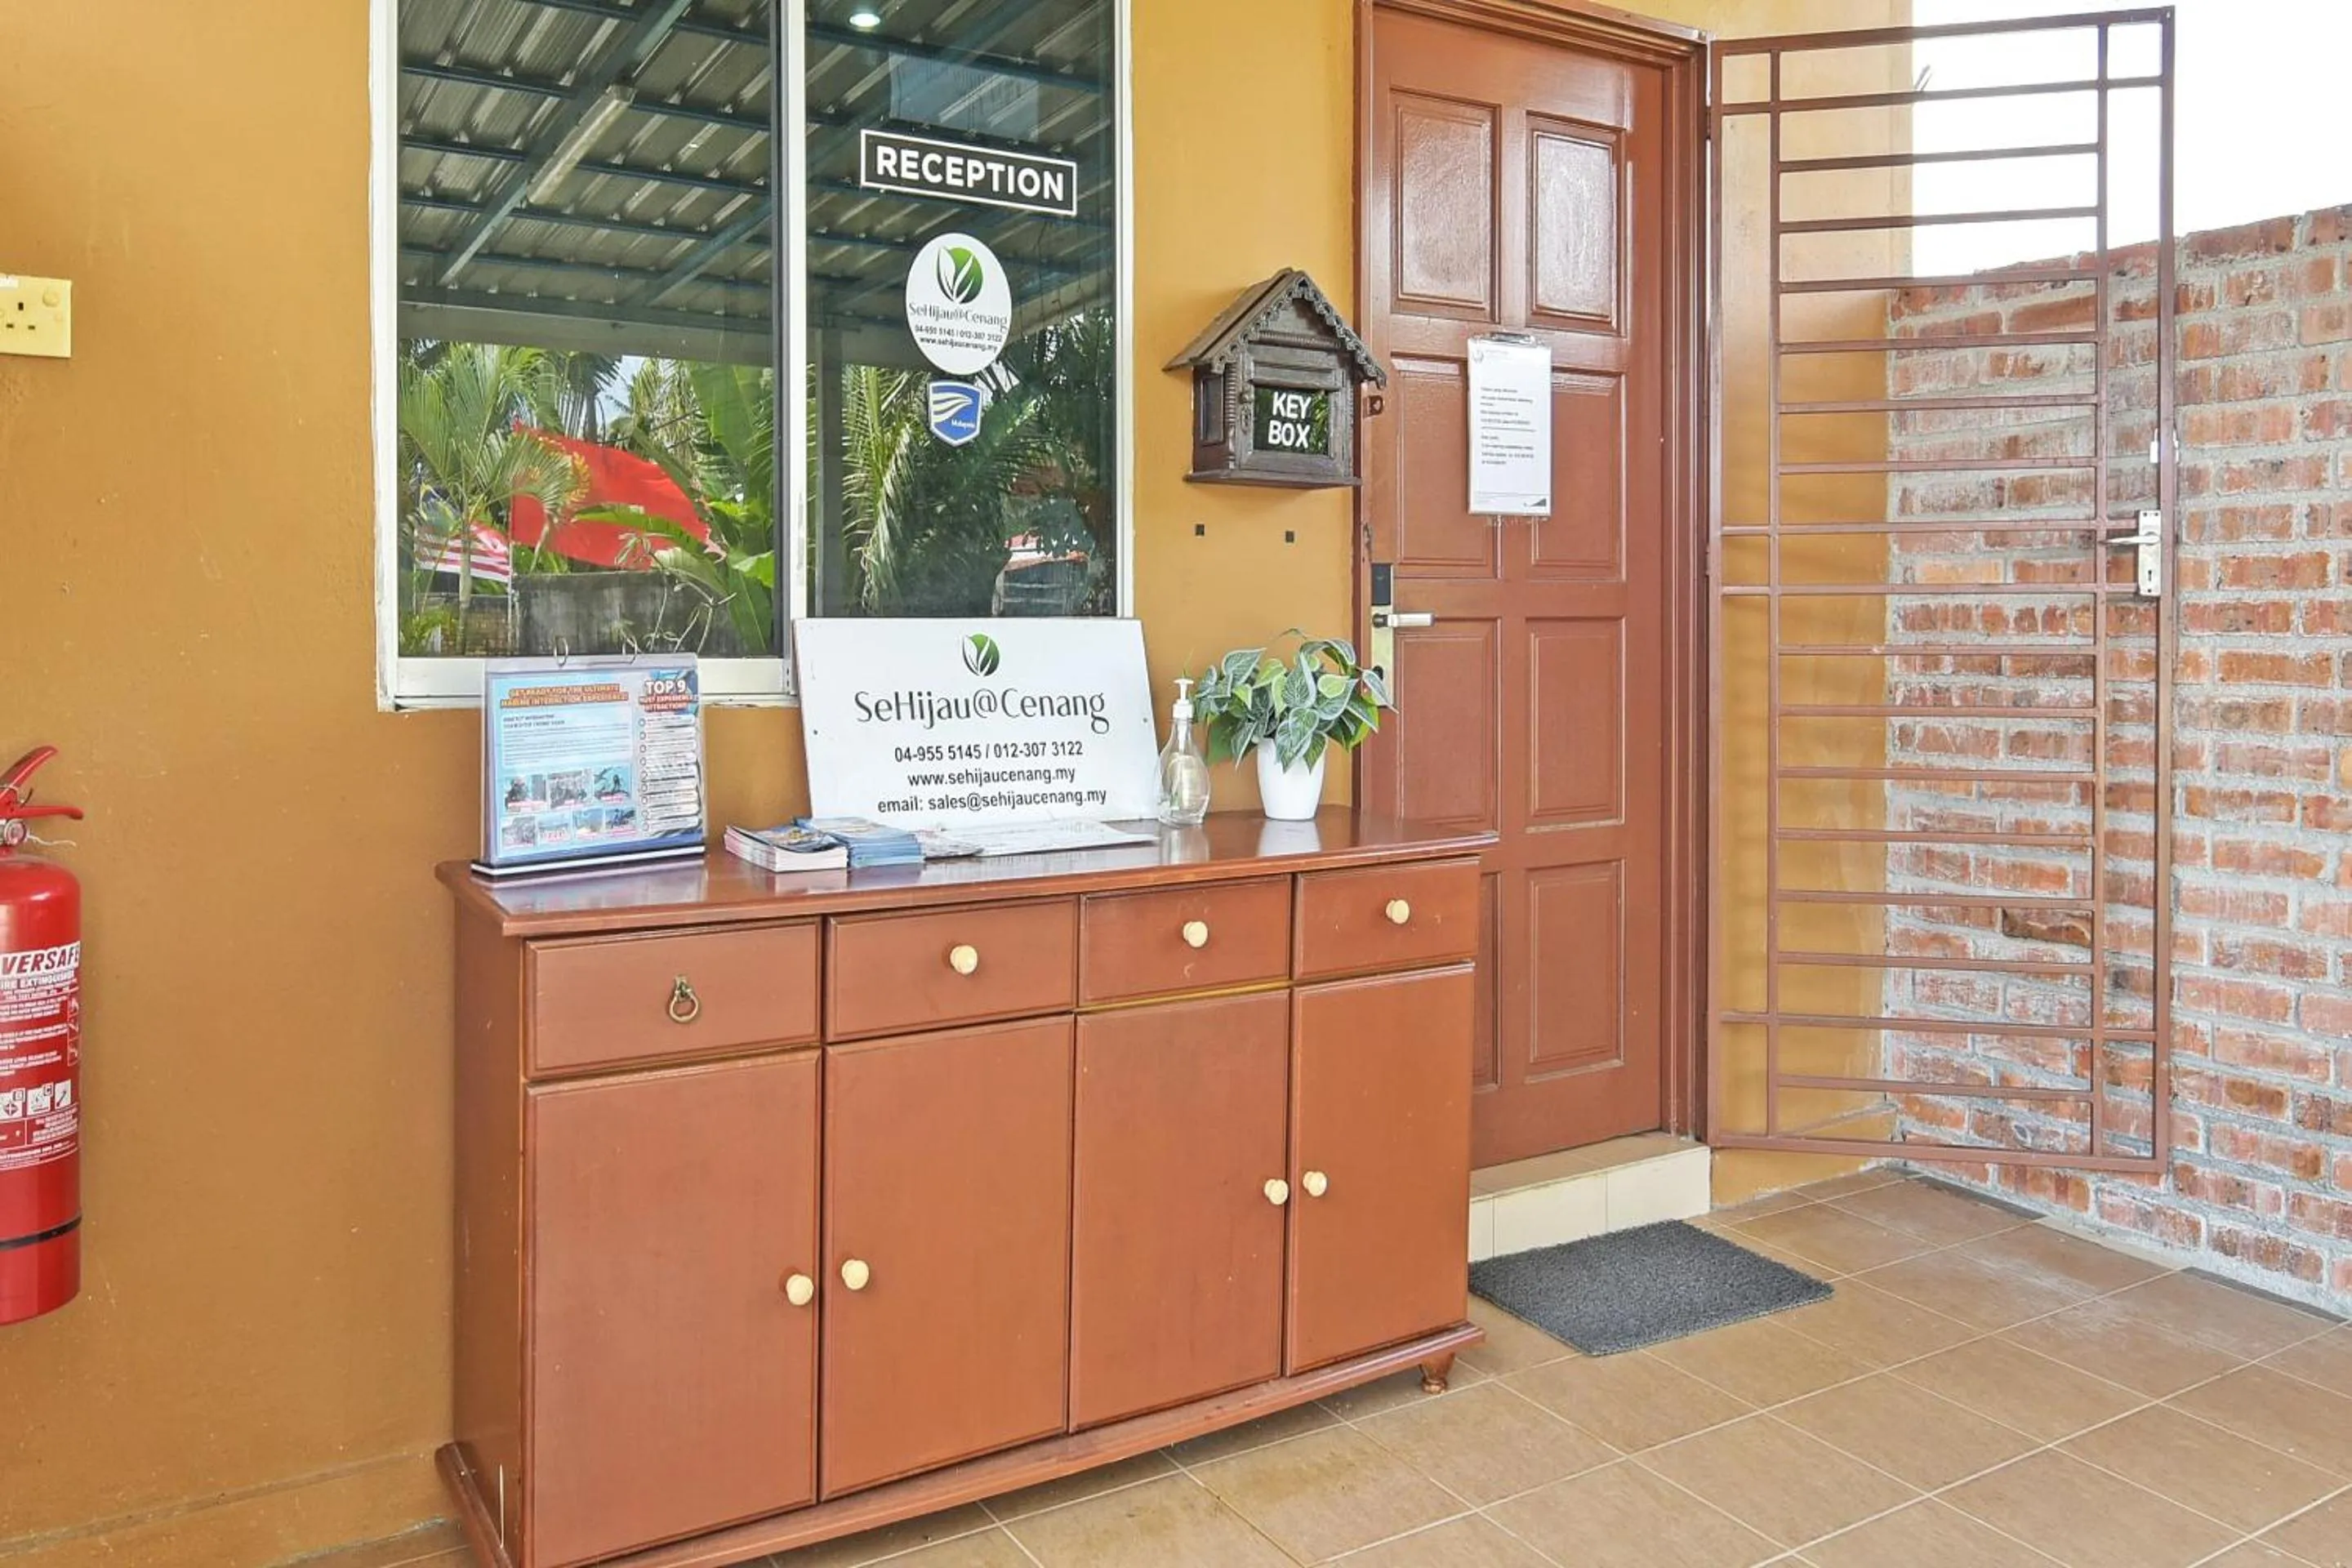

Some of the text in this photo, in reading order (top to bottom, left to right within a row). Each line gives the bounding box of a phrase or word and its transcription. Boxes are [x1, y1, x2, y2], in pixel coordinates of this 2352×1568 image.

[876, 145, 1063, 201] RECEPTION
[1272, 391, 1312, 420] KEY
[1268, 420, 1311, 448] BOX
[645, 679, 686, 694] TOP 9
[854, 688, 1110, 734] SeHijau@Cenang
[894, 745, 943, 762] 04-955
[948, 744, 982, 760] 5145
[994, 742, 1047, 758] 012-307
[1052, 741, 1084, 756] 3122
[907, 768, 1076, 787] www.sehijaucenang.my
[878, 790, 1107, 813] email: sales@sehijaucenang.my
